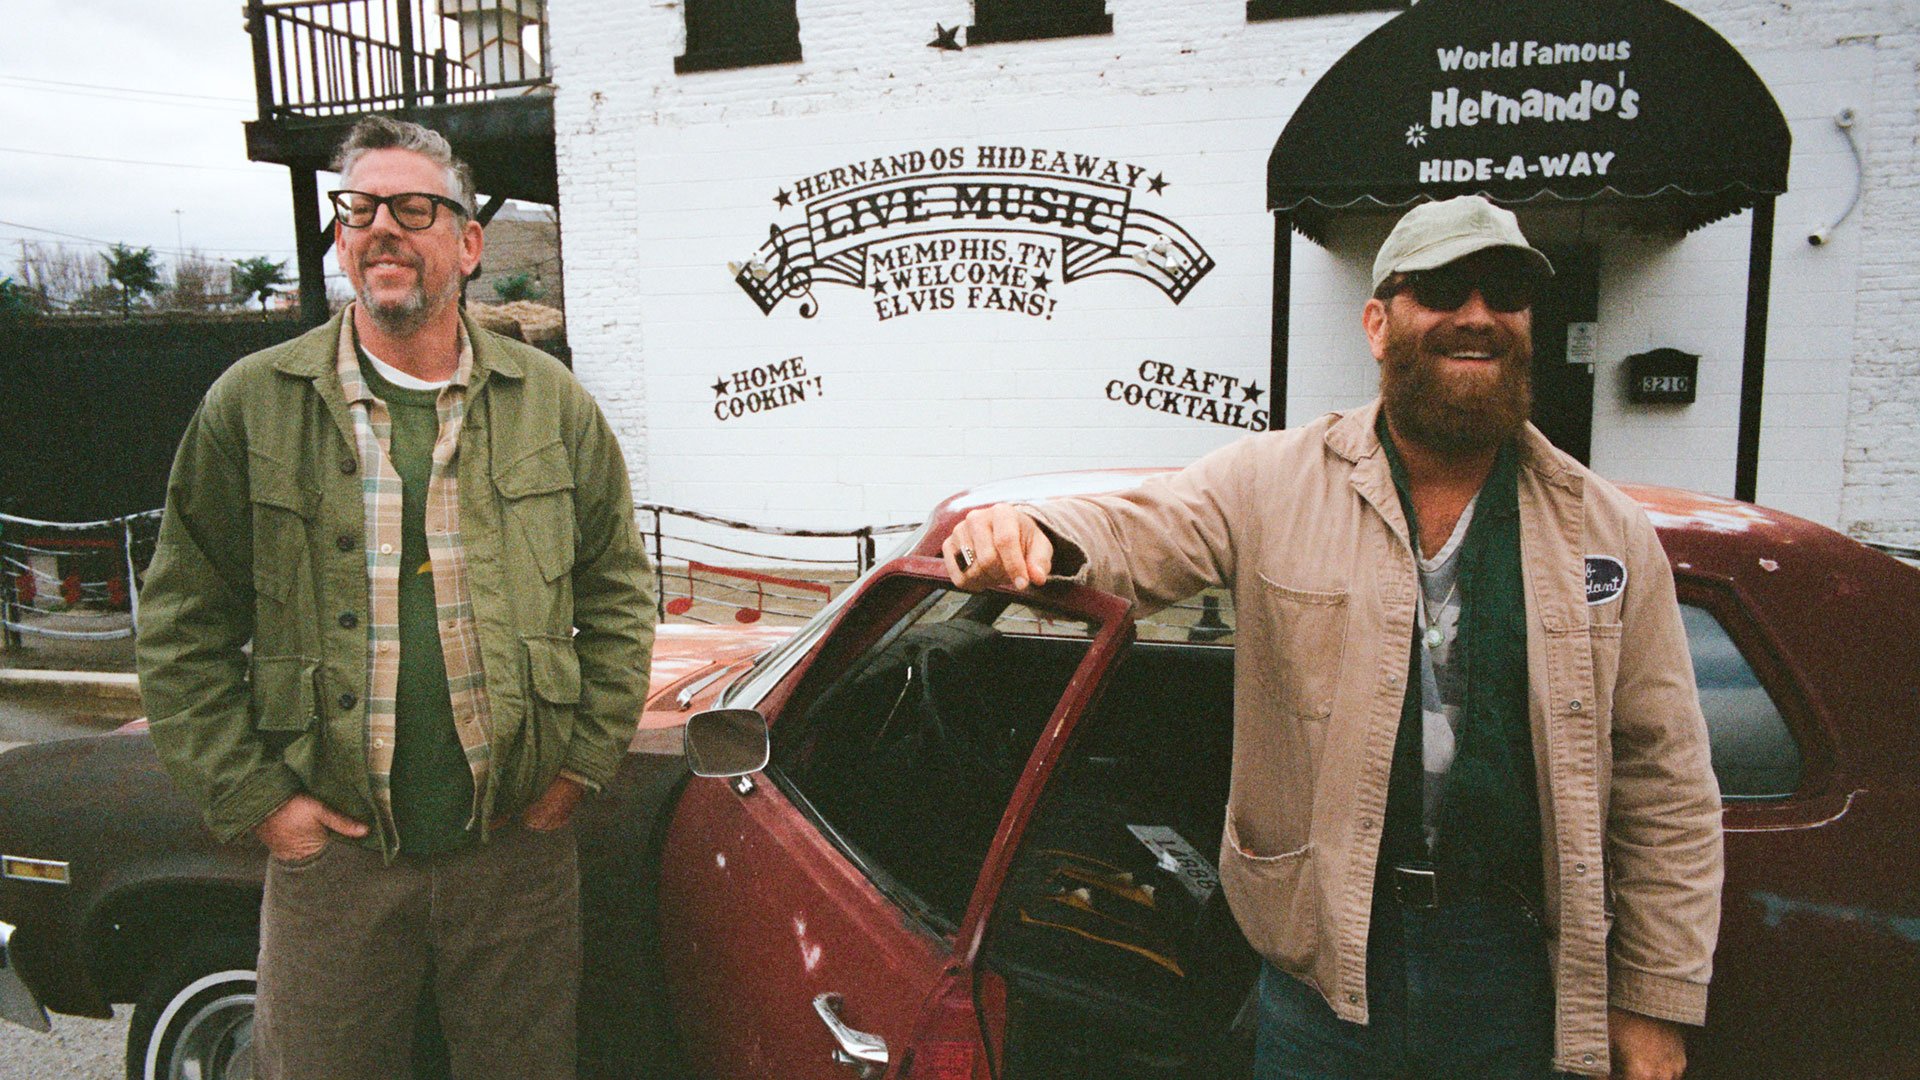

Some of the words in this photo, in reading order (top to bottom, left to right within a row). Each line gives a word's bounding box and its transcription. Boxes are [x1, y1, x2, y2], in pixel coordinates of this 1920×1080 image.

[1437, 41, 1518, 71] World
[1523, 40, 1631, 66] Famous
[1430, 70, 1640, 129] Hernando's
[794, 147, 965, 202] HERNANDOS
[976, 145, 1147, 188] HIDEAWAY
[1419, 151, 1615, 183] HIDE-A-WAY
[816, 186, 931, 243] LIVE
[956, 183, 1114, 236] MUSIC
[890, 262, 1028, 291] WELCOME
[874, 286, 955, 322] ELVIS
[967, 286, 1058, 321] FANS!
[731, 355, 807, 393] HOME
[1138, 359, 1239, 399] CRAFT
[1643, 376, 1688, 392] 3210
[714, 375, 823, 421] COOKIN'!
[1105, 379, 1269, 433] COCKTAILS
